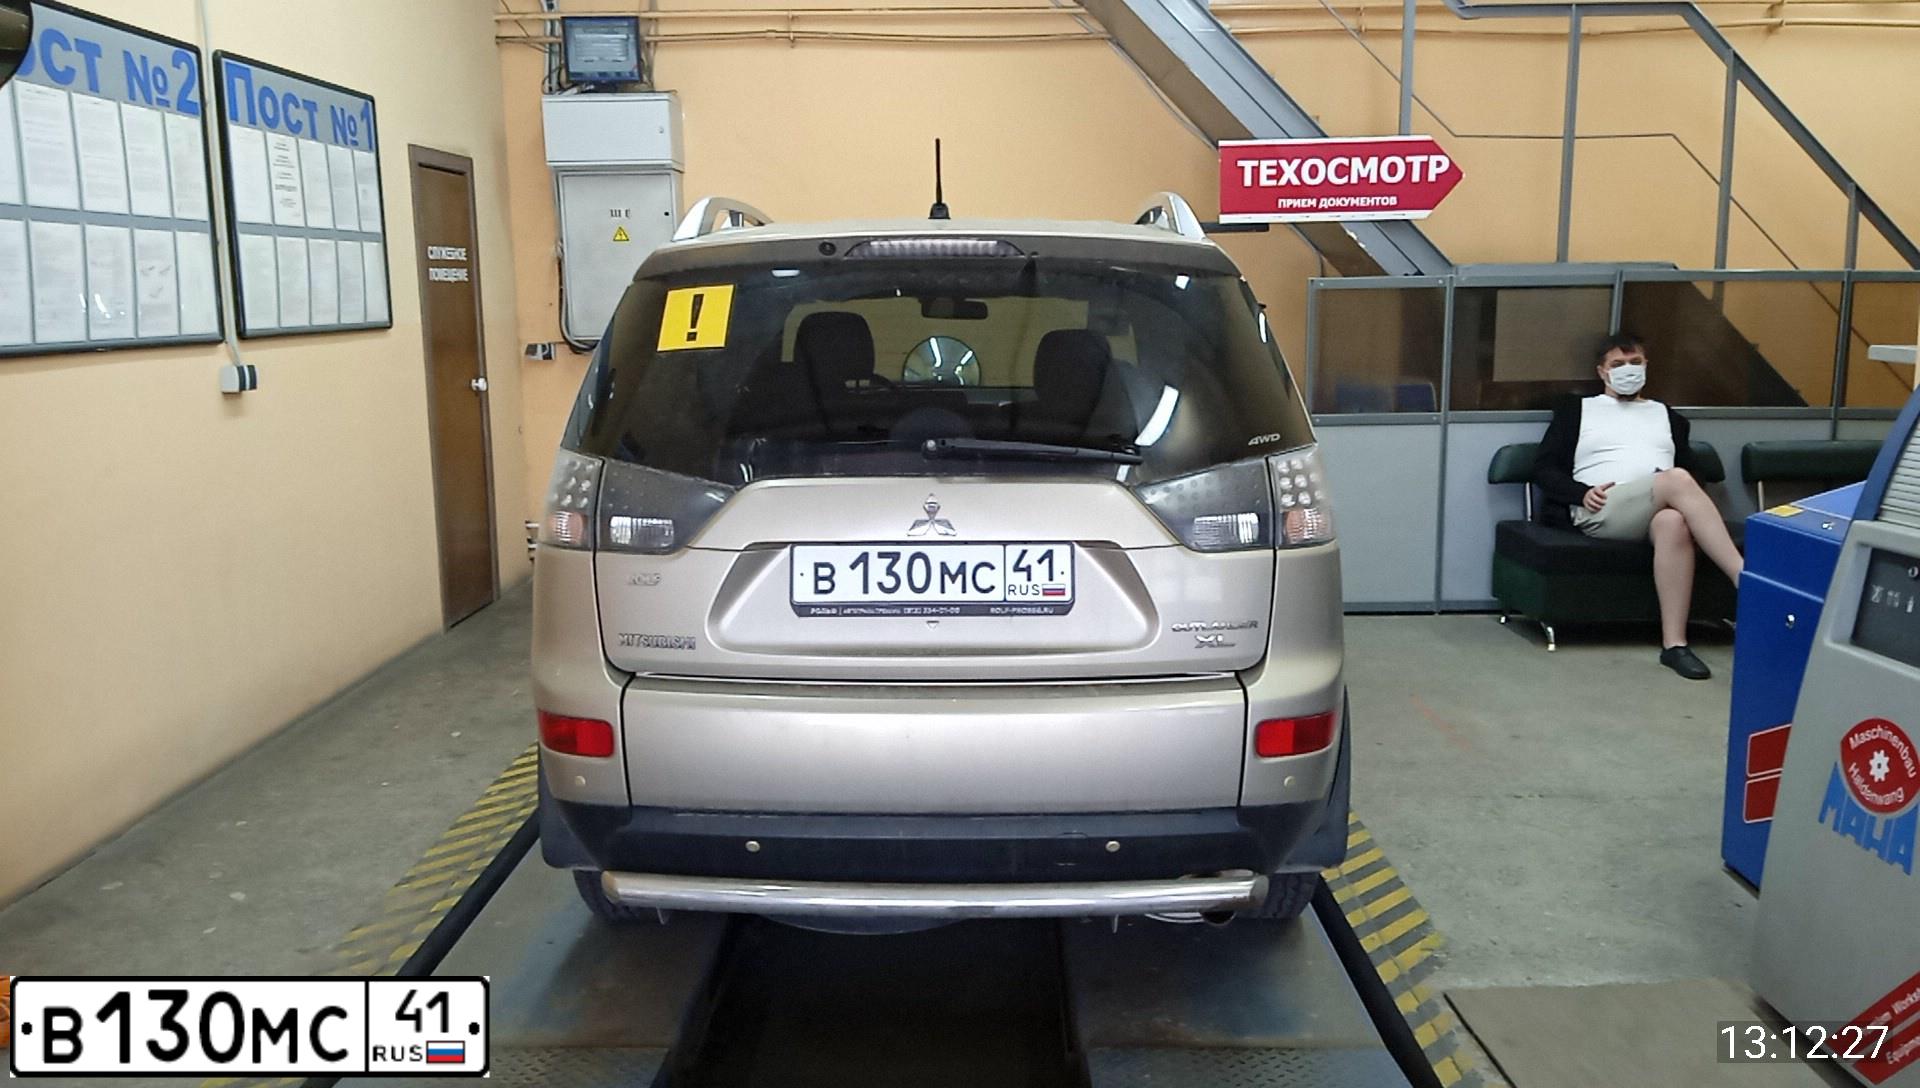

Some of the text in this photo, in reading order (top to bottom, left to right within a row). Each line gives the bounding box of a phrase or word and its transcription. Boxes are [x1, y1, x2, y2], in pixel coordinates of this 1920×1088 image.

[1237, 154, 1450, 188] ТЕХОСМОТР
[1277, 196, 1397, 209] ПРИЕМ ДОКУМЕНТОВ
[1248, 433, 1280, 446] AWD
[1013, 549, 1054, 582] 41
[1008, 584, 1040, 596] RUS
[618, 633, 696, 650] MITSUBISHI
[1849, 724, 1917, 779] Maschinenbau
[1818, 760, 1919, 876] MAHA
